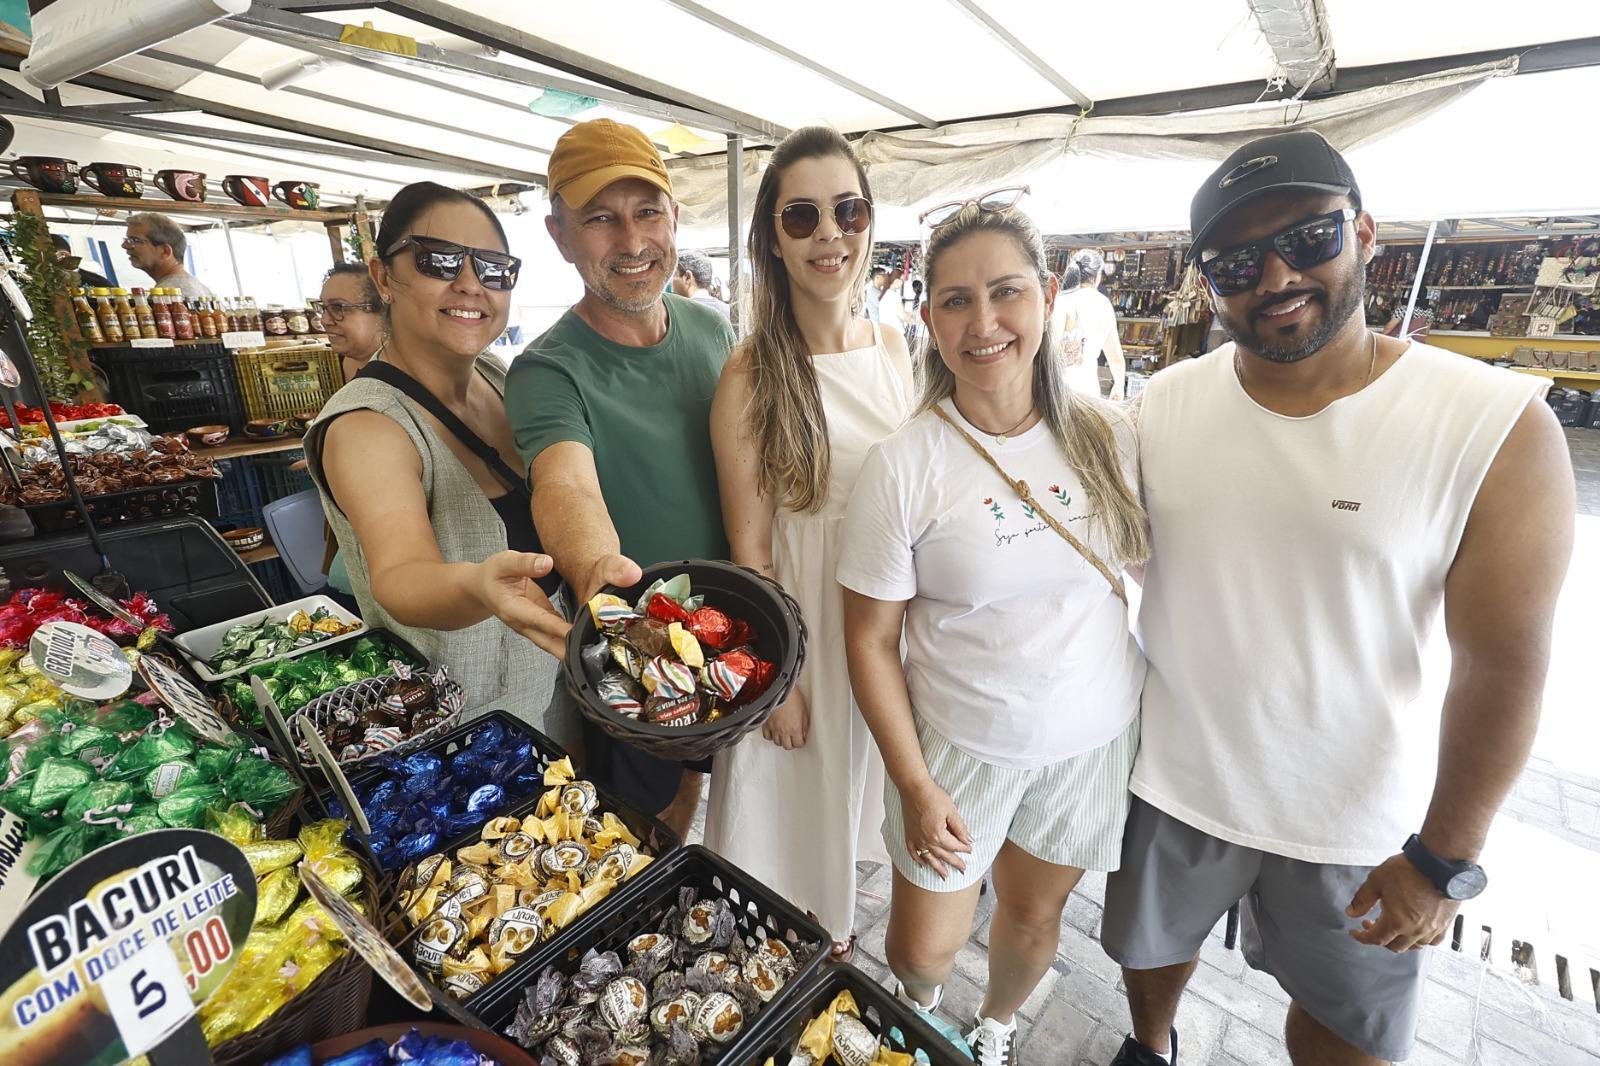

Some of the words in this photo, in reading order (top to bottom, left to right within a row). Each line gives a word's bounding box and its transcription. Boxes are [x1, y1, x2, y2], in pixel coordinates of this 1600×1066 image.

[47, 626, 77, 676] GRAVIOLA
[15, 970, 81, 1027] COM
[85, 928, 147, 983] DOCE
[152, 913, 181, 941] DE
[183, 876, 238, 921] LEITE
[33, 849, 202, 972] BACURI
[130, 969, 168, 1020] 5
